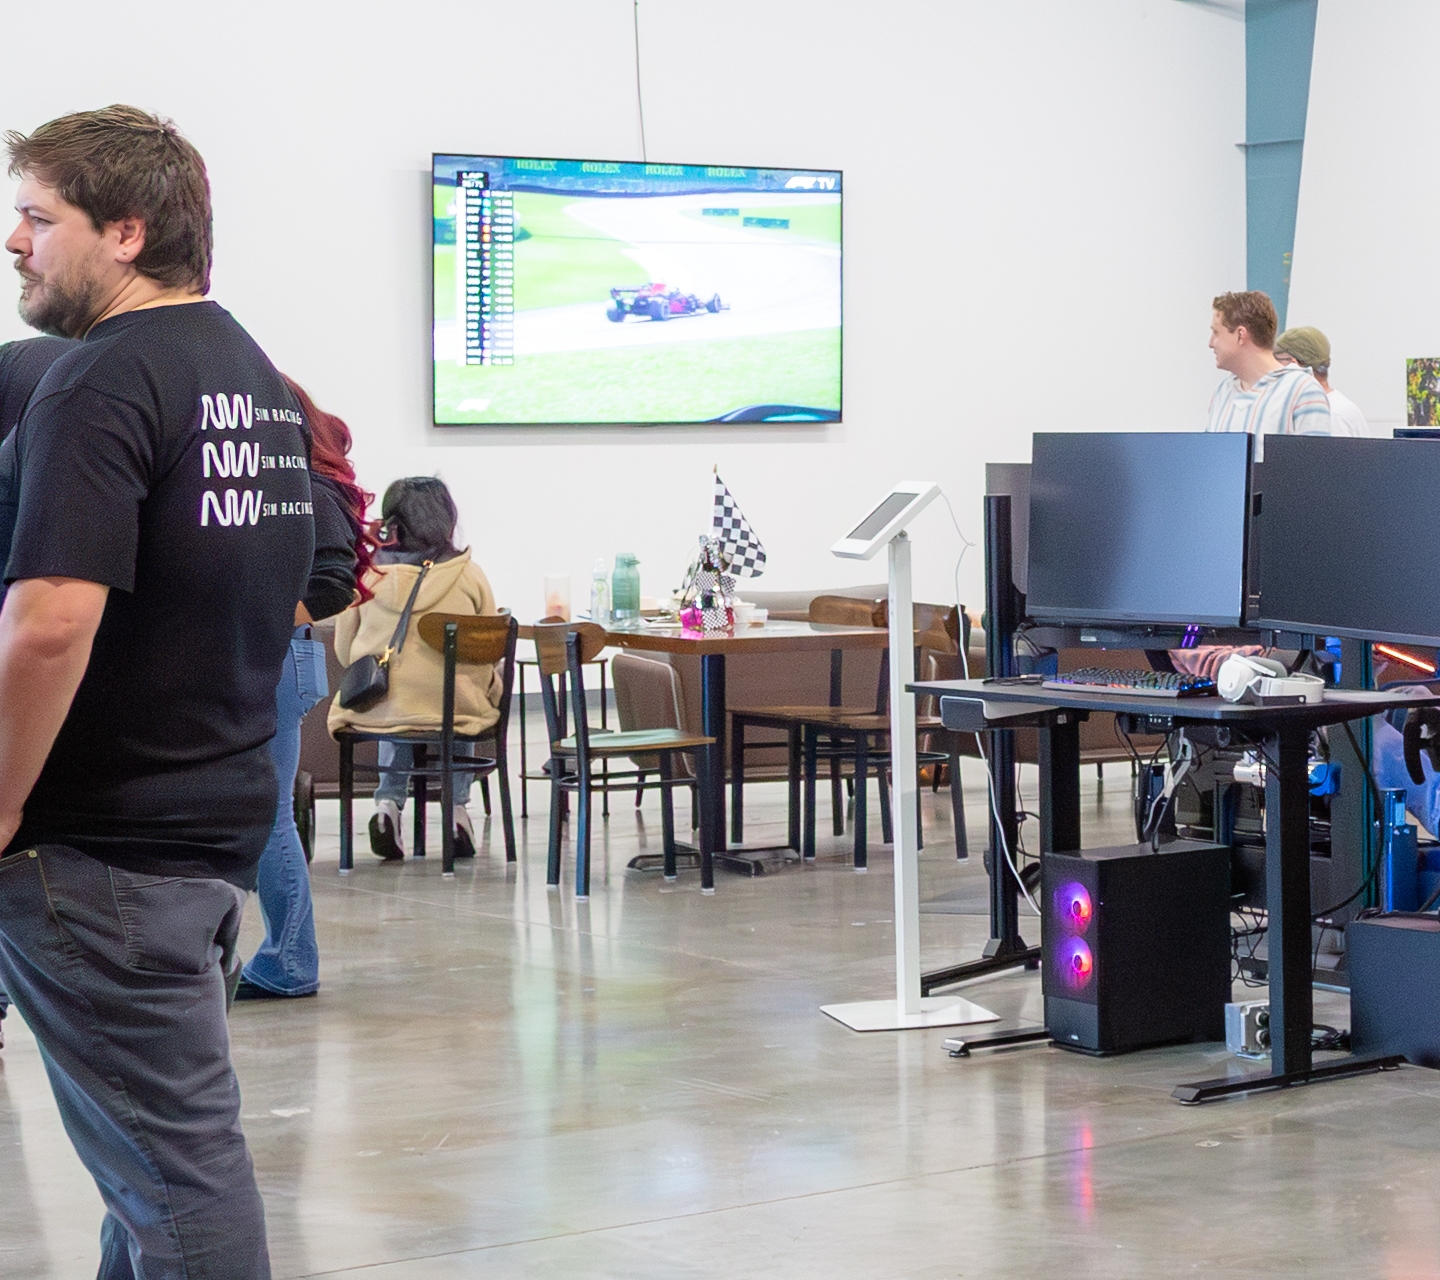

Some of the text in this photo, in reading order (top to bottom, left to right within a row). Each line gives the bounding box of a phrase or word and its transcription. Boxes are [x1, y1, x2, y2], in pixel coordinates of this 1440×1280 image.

[645, 164, 684, 177] ROLEX
[707, 167, 747, 179] ROLEX
[816, 176, 836, 191] TV
[254, 407, 270, 422] SIM
[272, 408, 303, 426] RACING
[261, 455, 276, 470] SIM
[262, 502, 278, 517] SIM
